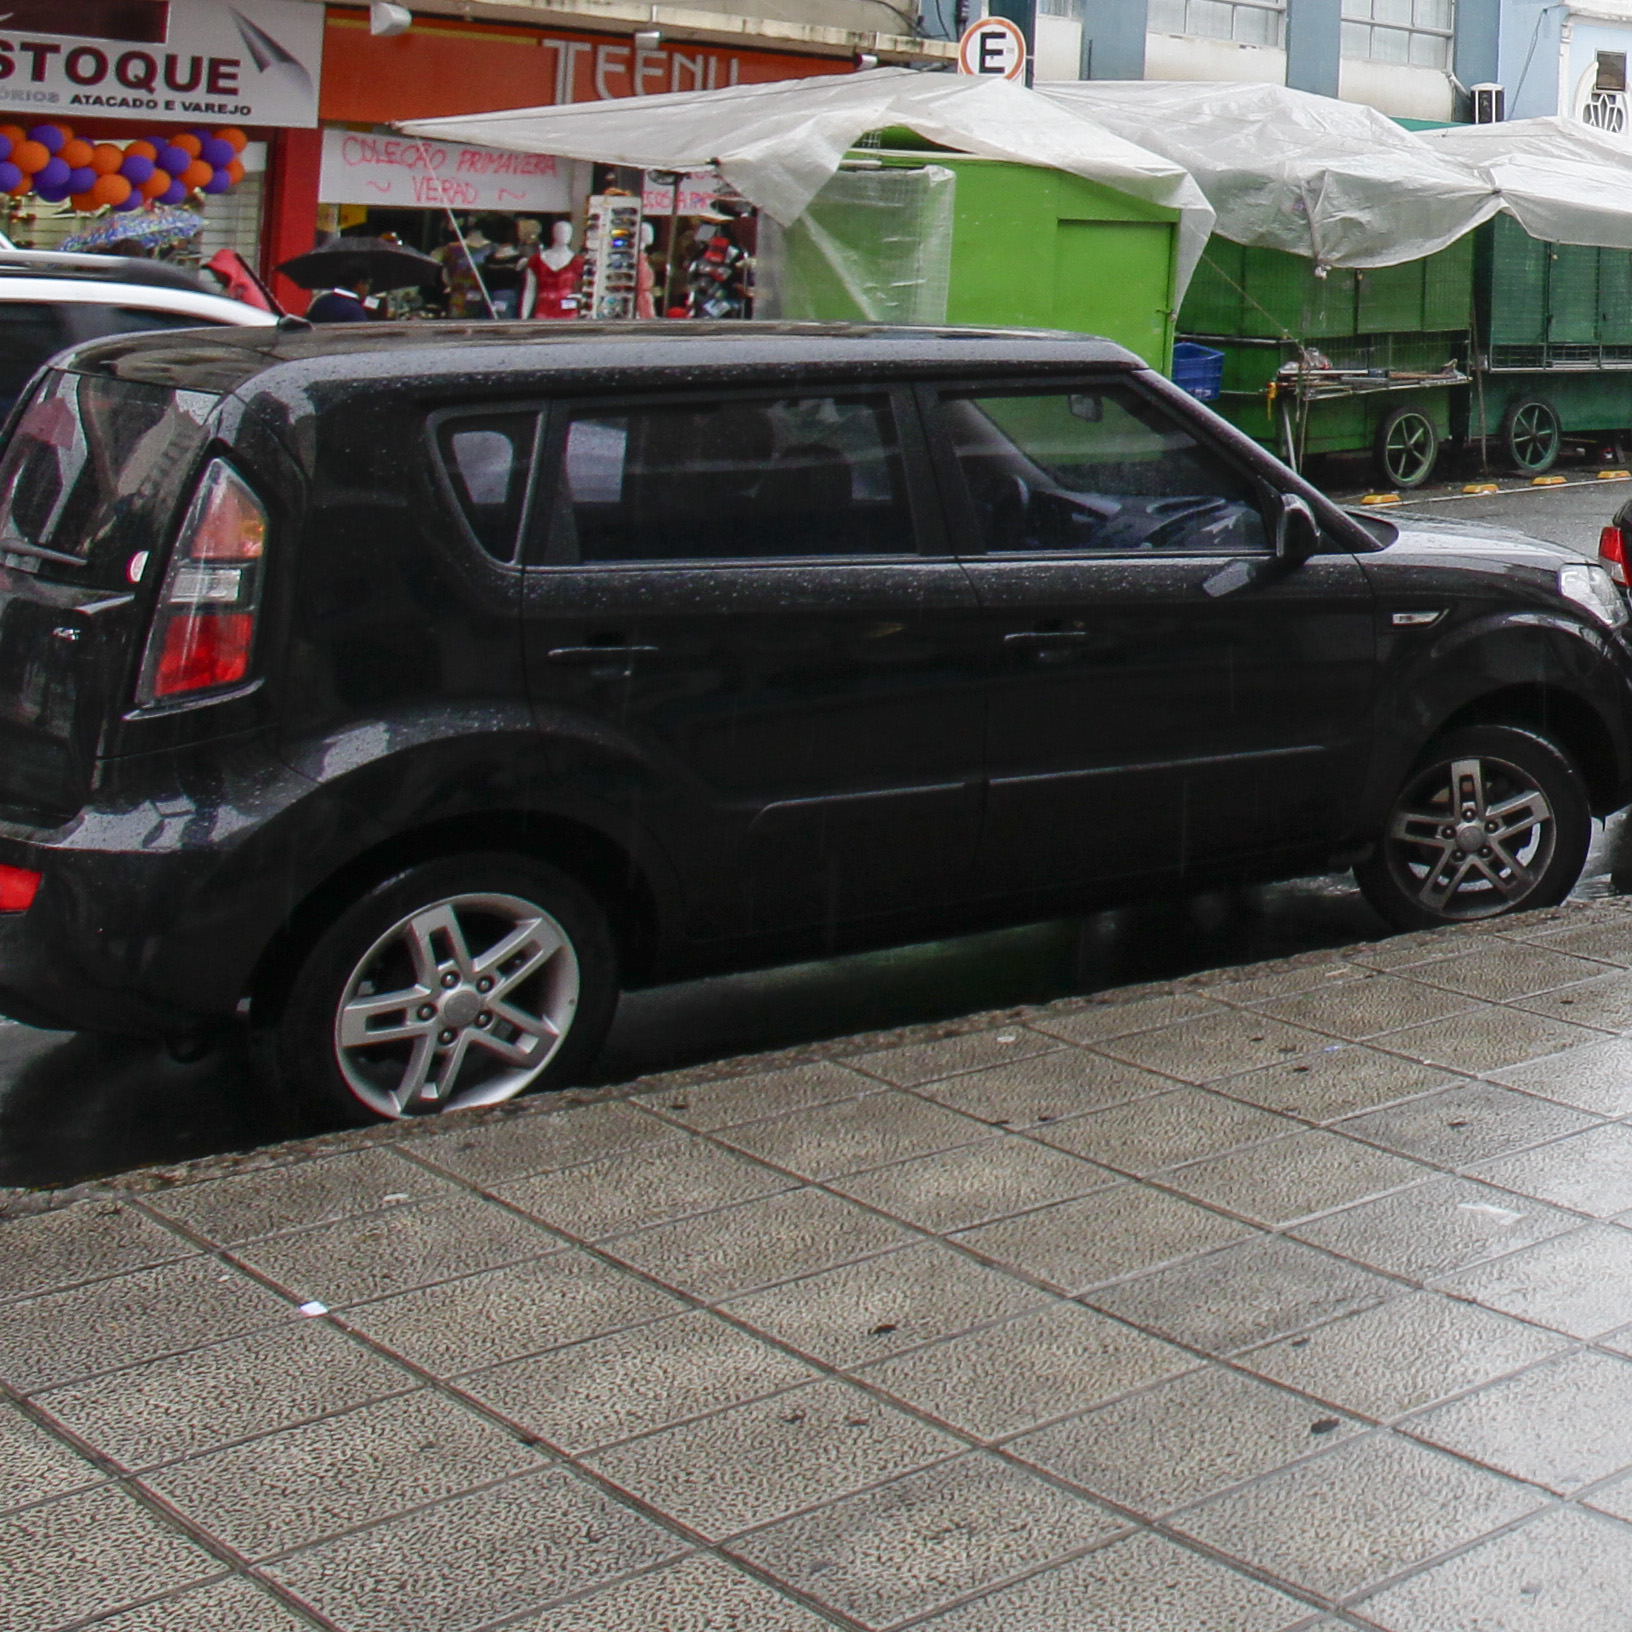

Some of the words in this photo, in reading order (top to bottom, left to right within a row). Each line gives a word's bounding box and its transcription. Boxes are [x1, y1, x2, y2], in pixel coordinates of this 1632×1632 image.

[979, 32, 1007, 74] E
[70, 93, 158, 110] ATACADO
[164, 100, 177, 111] E
[180, 101, 252, 117] VAREJO
[342, 135, 447, 170] COLEÇÃO
